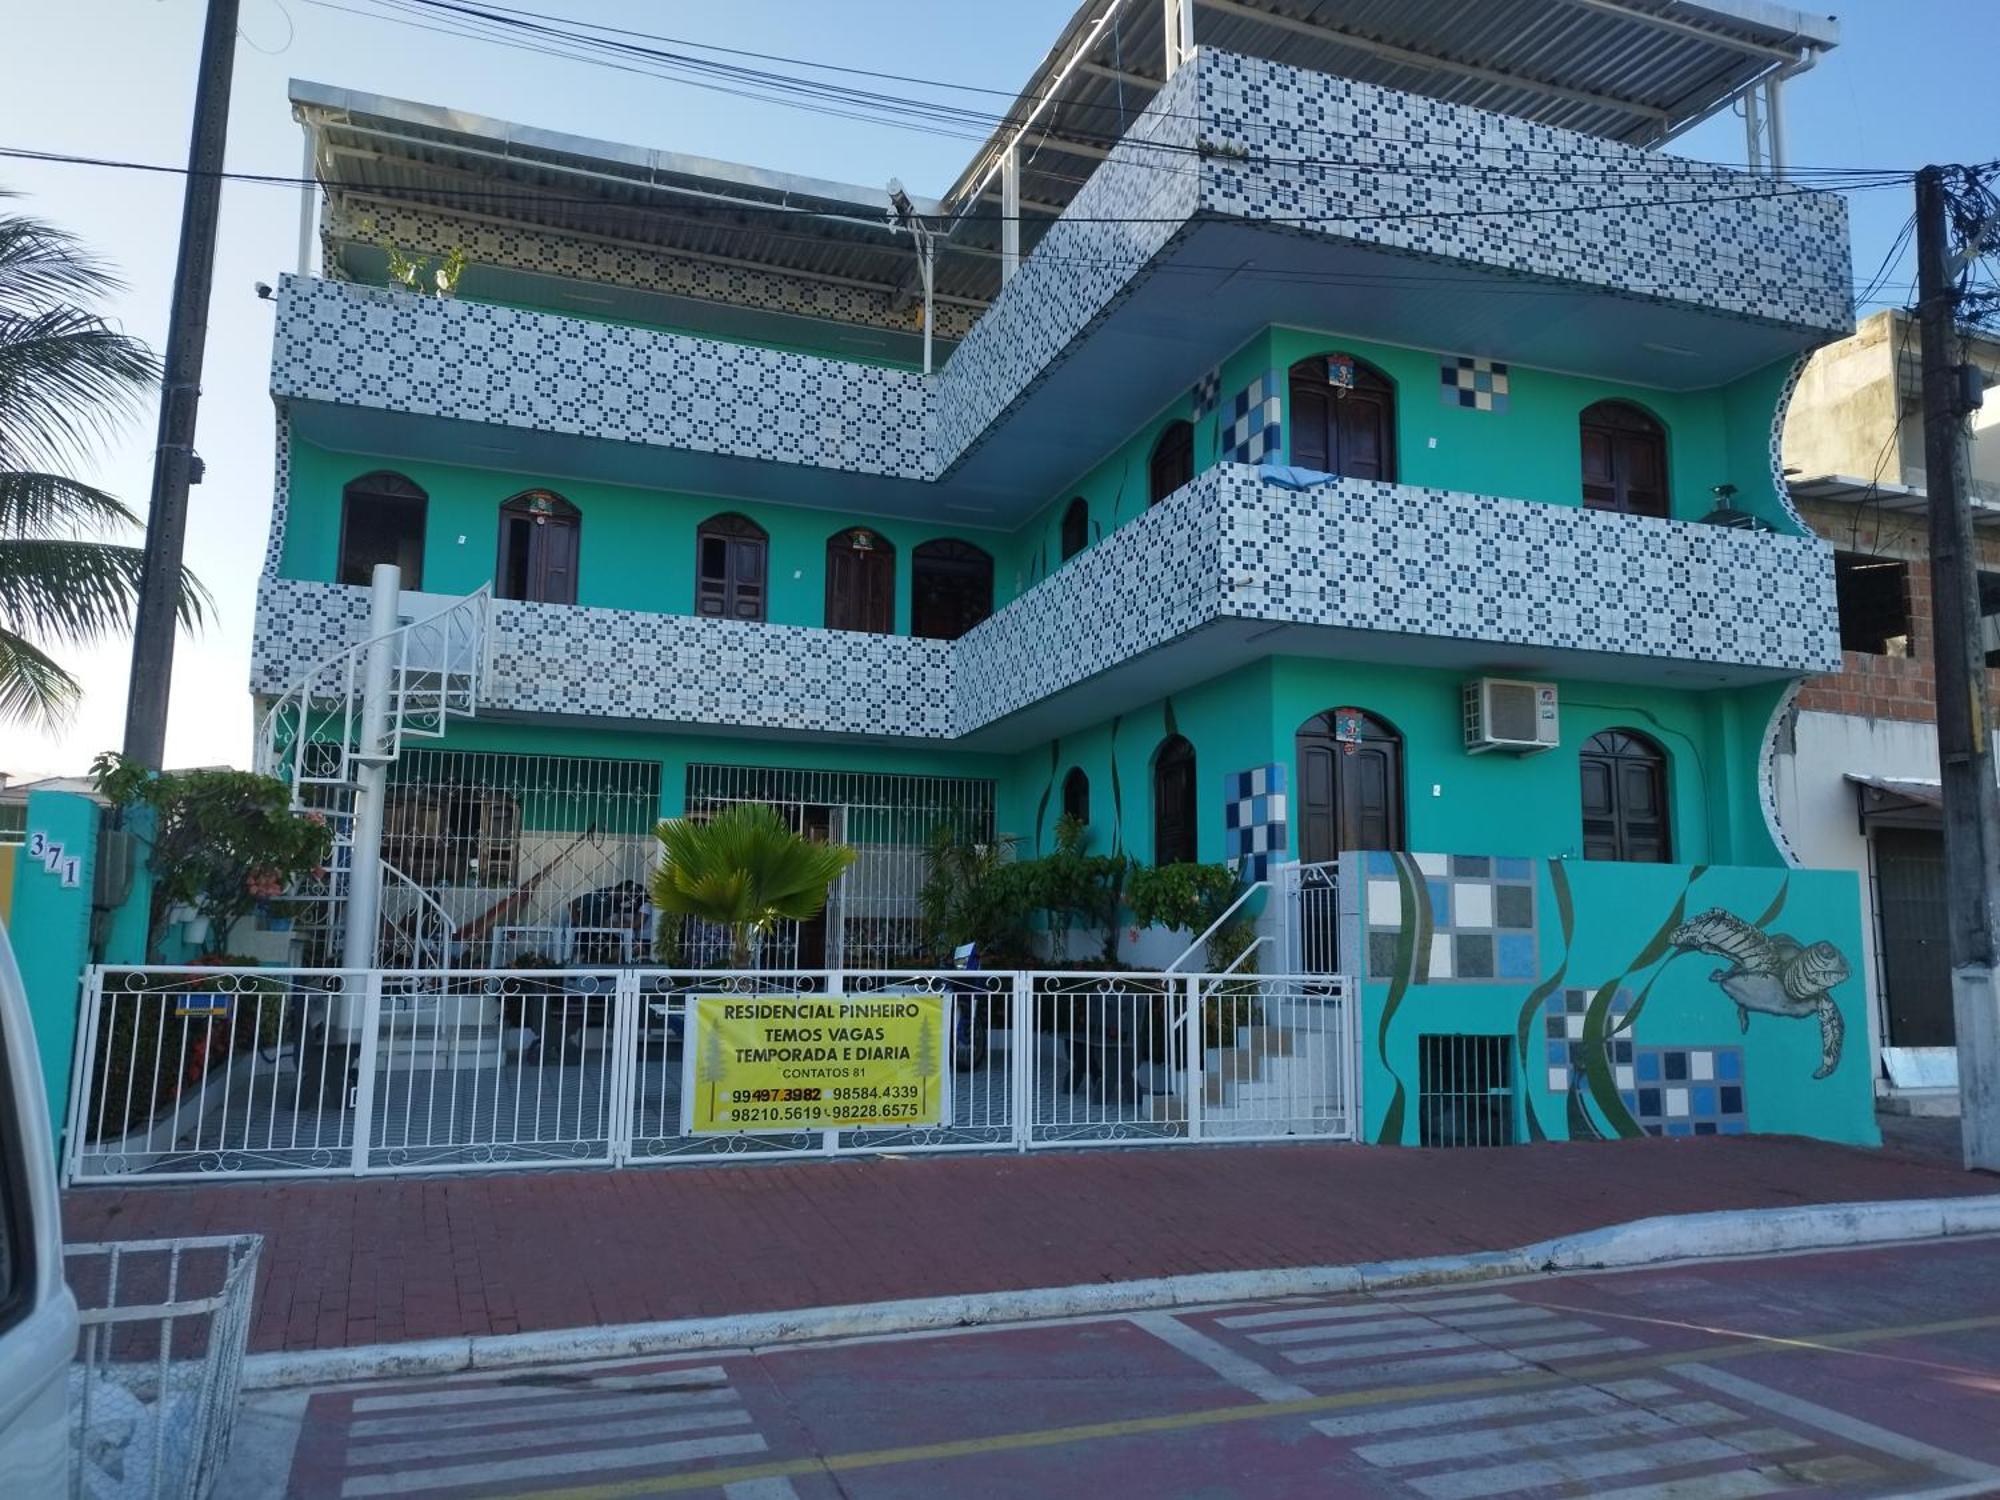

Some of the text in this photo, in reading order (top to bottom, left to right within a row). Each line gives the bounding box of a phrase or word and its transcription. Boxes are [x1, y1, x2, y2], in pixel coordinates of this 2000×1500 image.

[30, 834, 75, 882] 371
[725, 1004, 919, 1019] RESIDENCIAL PINHEIRO
[765, 1028, 884, 1042] TEMOS VAGAS
[736, 1047, 910, 1063] TEMPORADA E DIARIA
[783, 1068, 865, 1079] CONTATOS 81
[833, 1086, 918, 1100] 98584.4339
[731, 1104, 918, 1121] 98210.5619 98228.6575
